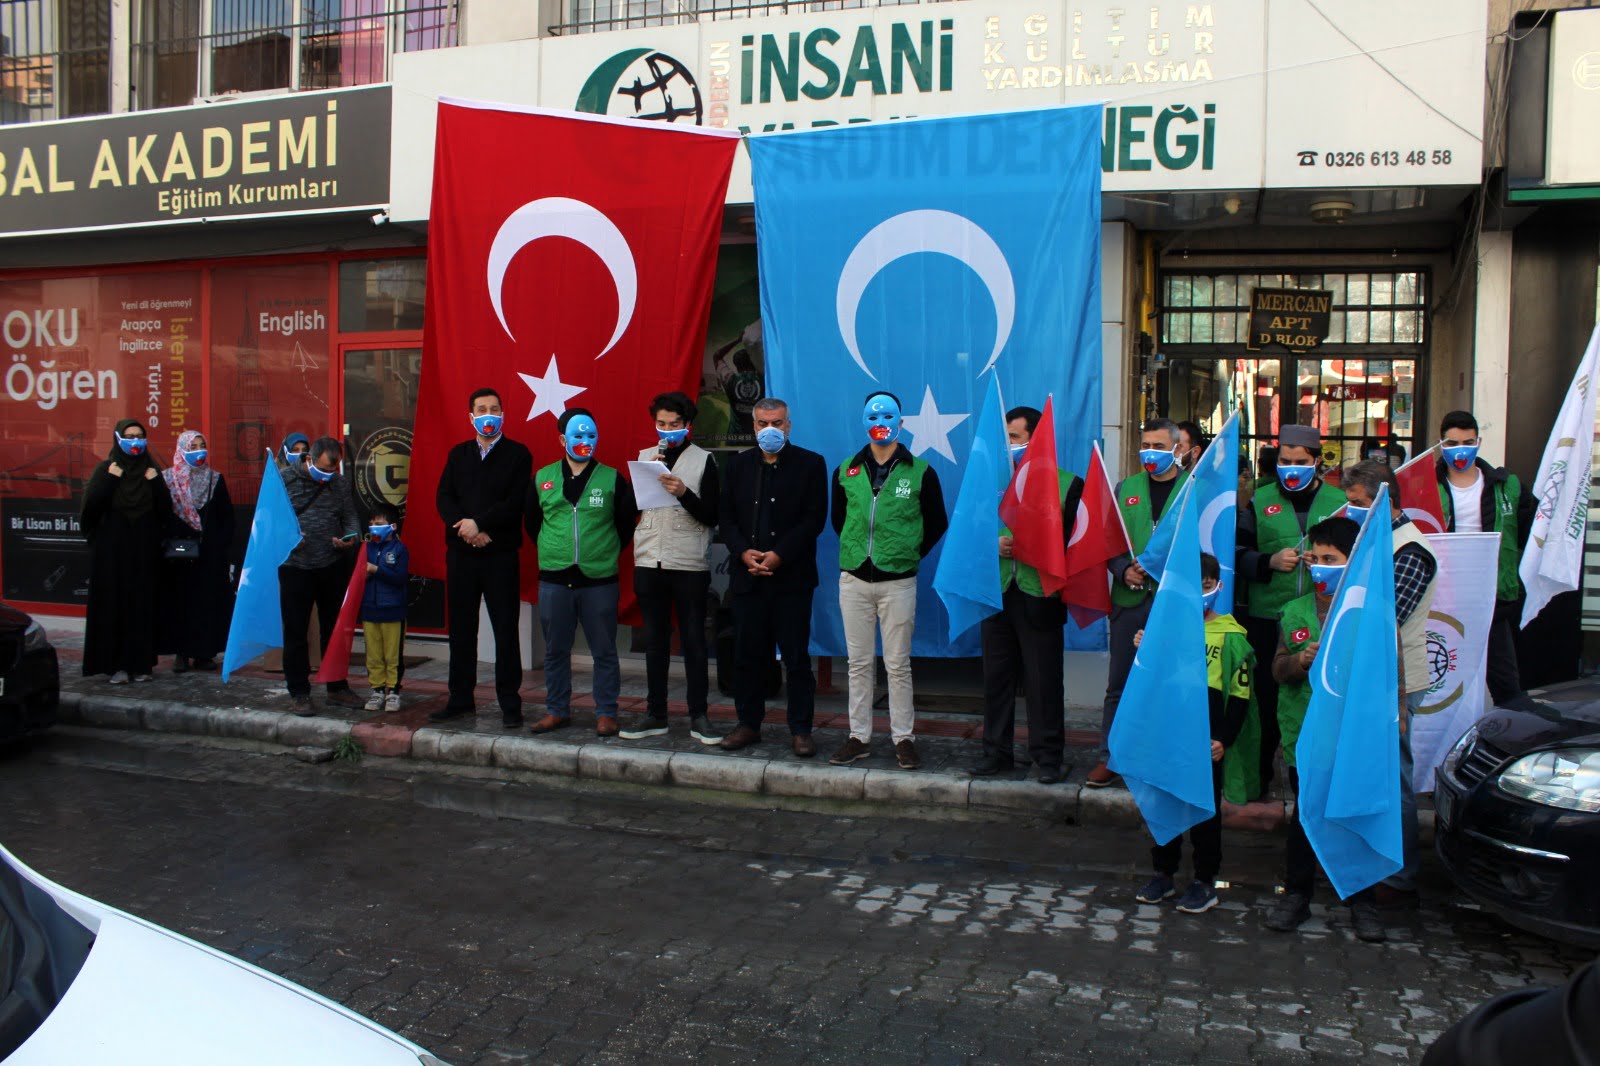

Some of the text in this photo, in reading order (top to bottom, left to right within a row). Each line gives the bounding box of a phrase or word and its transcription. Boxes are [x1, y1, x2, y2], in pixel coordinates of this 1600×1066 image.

[89, 99, 337, 189] AKADEMİ
[1325, 150, 1451, 167] 0326 613 48 58
[158, 178, 337, 215] Eğitim Kurumları
[1256, 293, 1329, 313] MERCAN
[3, 308, 79, 349] OKU
[120, 319, 161, 332] Arapça
[259, 309, 325, 336] English
[1269, 316, 1312, 330] APT
[119, 337, 163, 353] İngilizce
[1259, 333, 1271, 344] D
[6, 353, 118, 410] Öğren
[146, 362, 162, 429] Türkçe
[11, 517, 24, 529] Bir
[27, 517, 52, 530] Lisan
[54, 518, 68, 530] Bir
